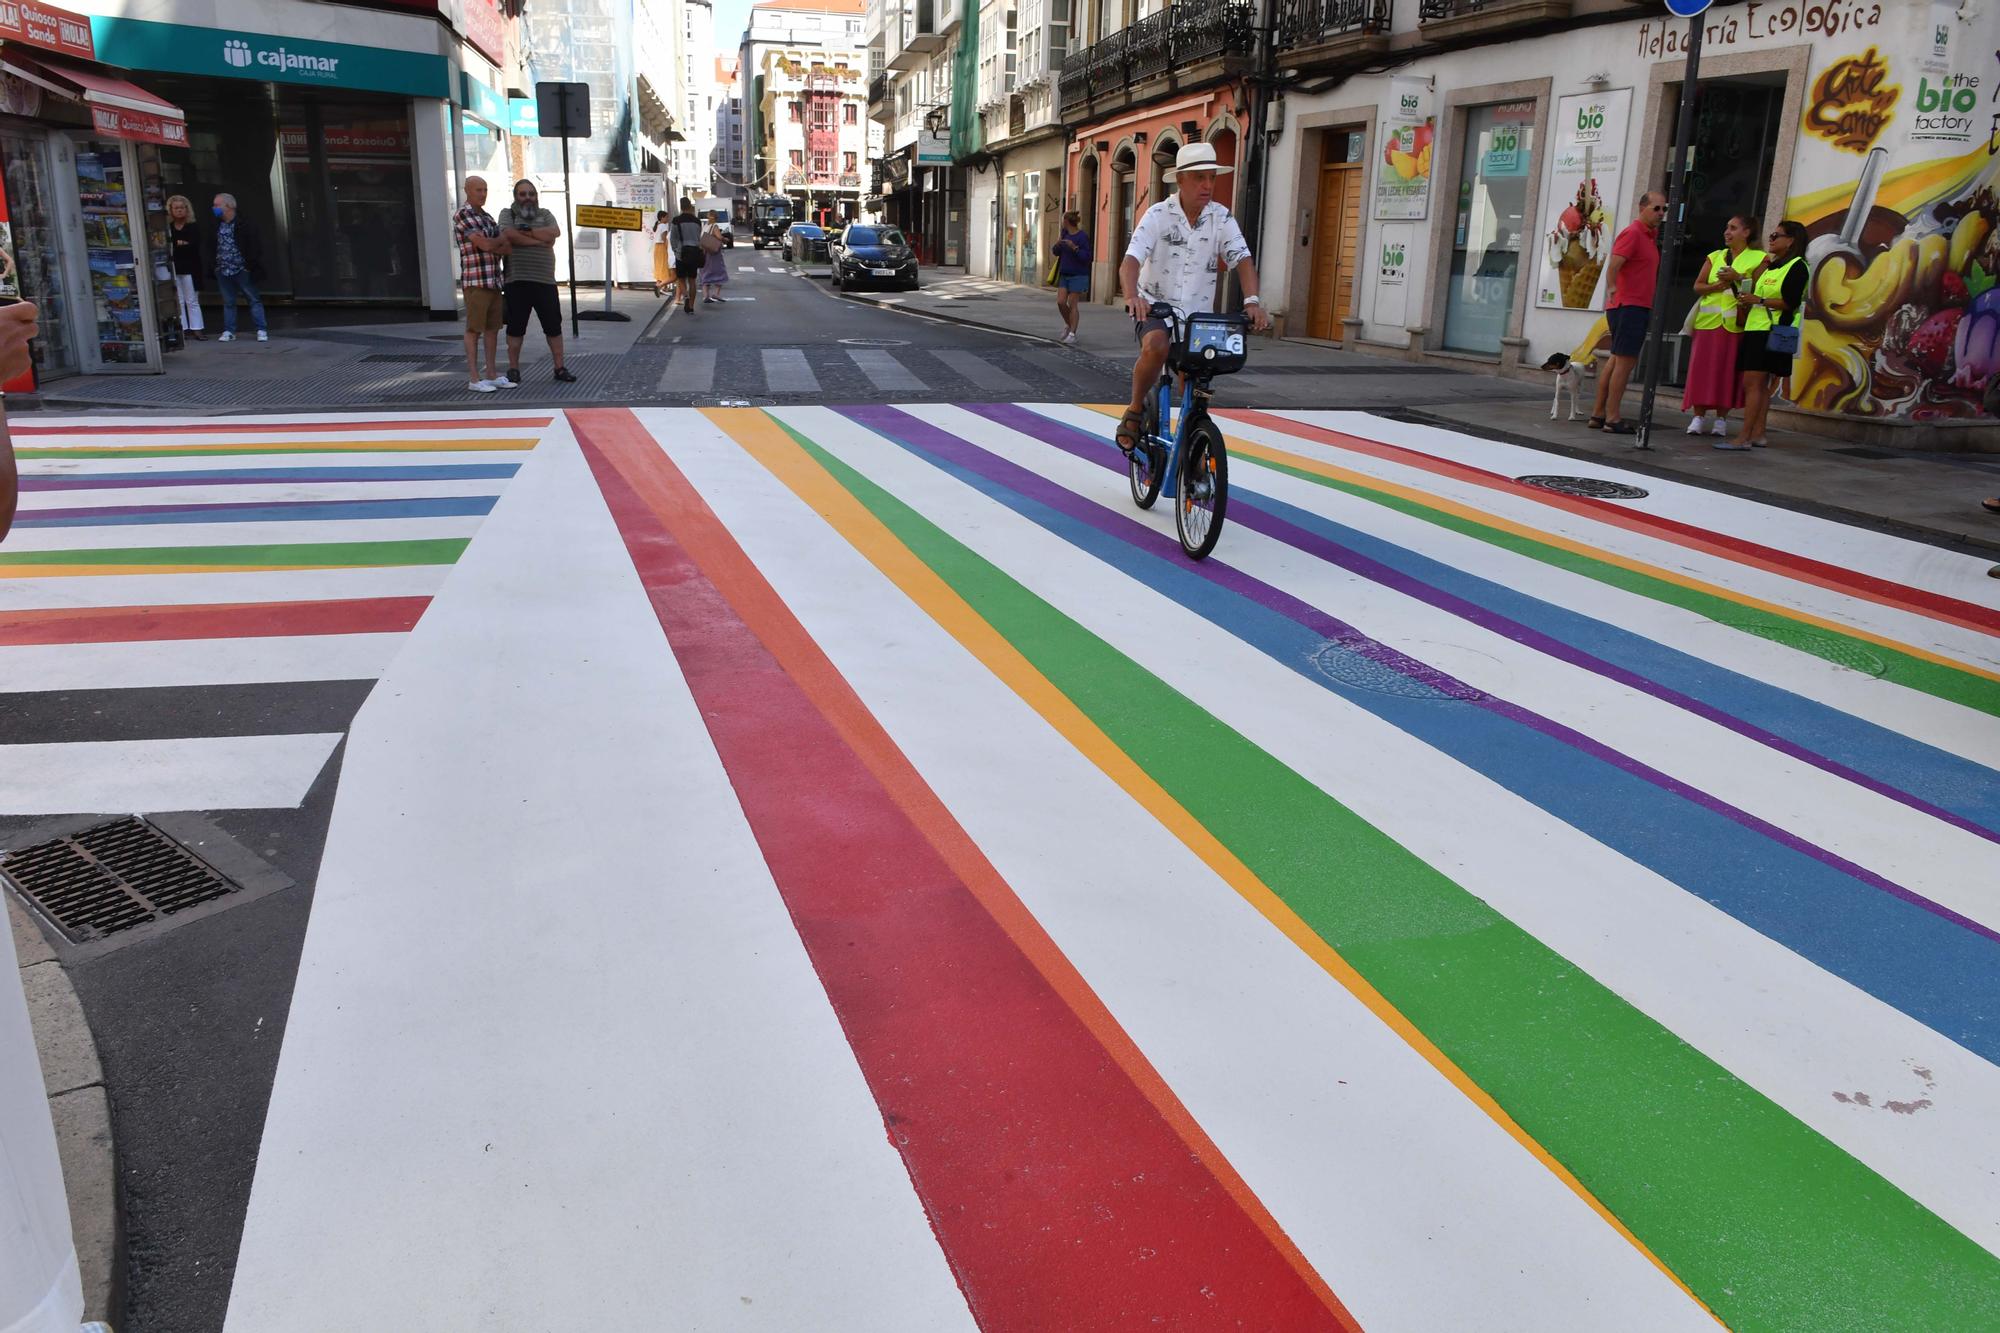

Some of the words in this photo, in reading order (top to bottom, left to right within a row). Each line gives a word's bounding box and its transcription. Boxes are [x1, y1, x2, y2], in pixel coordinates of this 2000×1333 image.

[0, 5, 19, 28] OLA!
[20, 4, 57, 27] Quiosco
[27, 26, 56, 45] Sande
[60, 21, 89, 47] ¡HOLA!
[257, 47, 339, 73] cajamar
[1953, 73, 1980, 88] the
[1400, 94, 1418, 108] bio
[1916, 75, 1977, 113] bio
[1577, 106, 1604, 130] bio
[1914, 115, 1974, 133] factory
[1575, 130, 1601, 140] factory
[1382, 244, 1404, 267] bio
